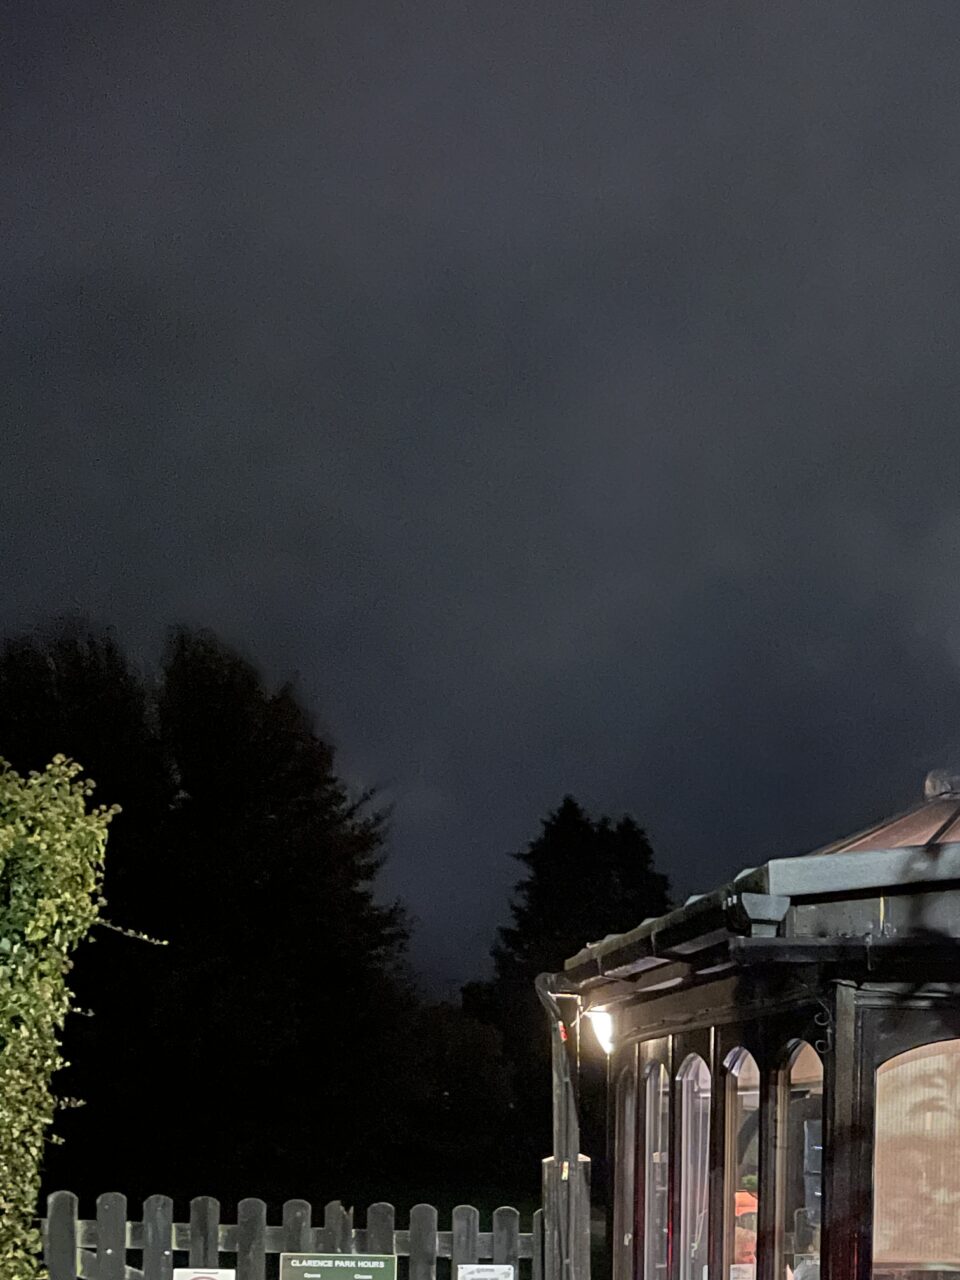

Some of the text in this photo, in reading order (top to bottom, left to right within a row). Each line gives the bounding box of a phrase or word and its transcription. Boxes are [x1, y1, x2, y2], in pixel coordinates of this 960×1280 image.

[291, 1259, 385, 1268] CLARENCE PARK HOURS
